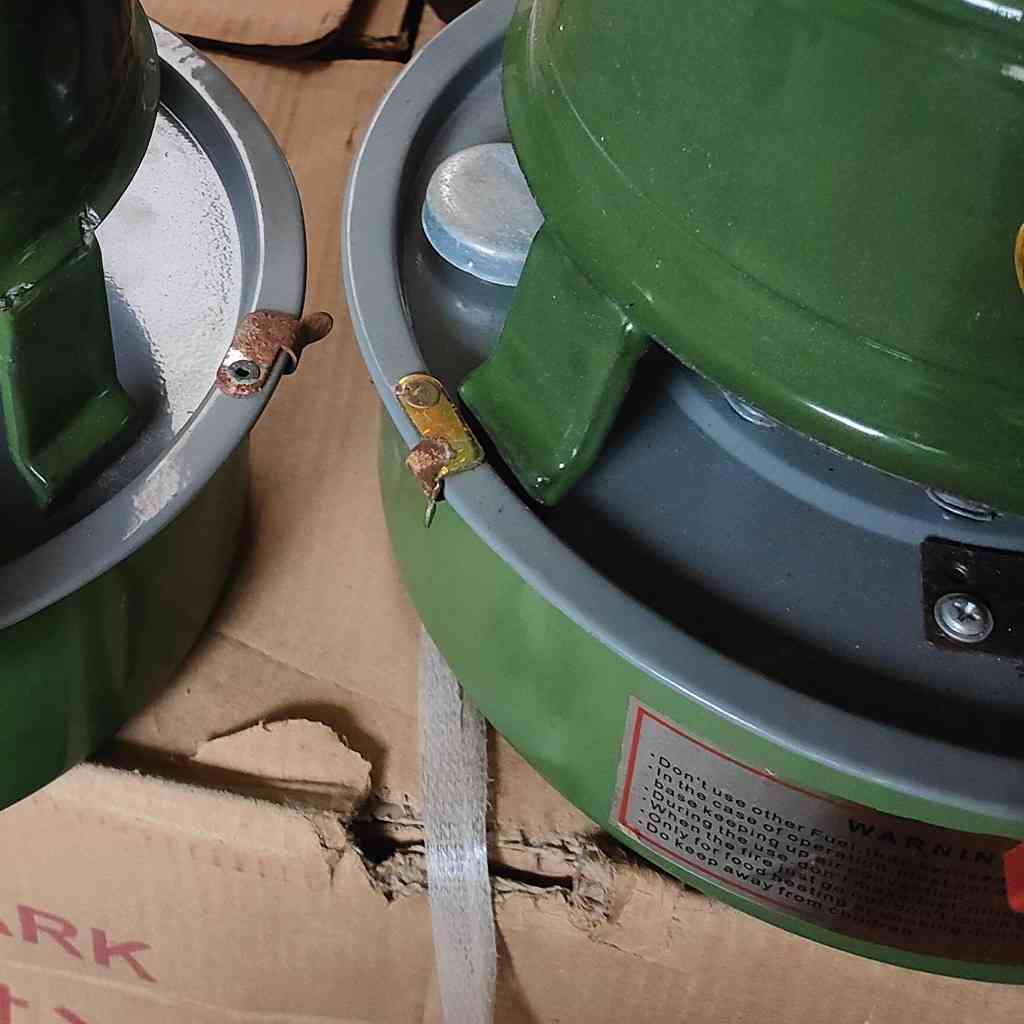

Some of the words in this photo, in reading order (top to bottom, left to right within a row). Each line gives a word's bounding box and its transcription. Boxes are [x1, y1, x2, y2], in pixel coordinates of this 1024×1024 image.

[652, 789, 713, 830] During
[719, 825, 748, 845] the
[754, 843, 788, 863] use
[654, 778, 698, 808] base
[703, 805, 779, 849] keeping
[786, 844, 809, 858] up
[657, 767, 673, 783] In
[678, 780, 706, 801] the
[712, 799, 757, 825] case
[763, 823, 784, 835] of
[658, 756, 707, 790] Don't
[713, 787, 746, 808] use
[752, 807, 806, 832] other
[646, 822, 670, 841] Do
[675, 838, 718, 866] keep
[723, 865, 773, 891] away
[778, 886, 822, 909] from
[648, 812, 689, 840] Only
[695, 836, 719, 855] for
[724, 851, 766, 876] food
[772, 872, 847, 907] heating
[650, 799, 700, 834] When
[706, 832, 735, 851] the
[740, 847, 773, 867] fire
[777, 863, 815, 884] just
[848, 818, 995, 866] WARNIN
